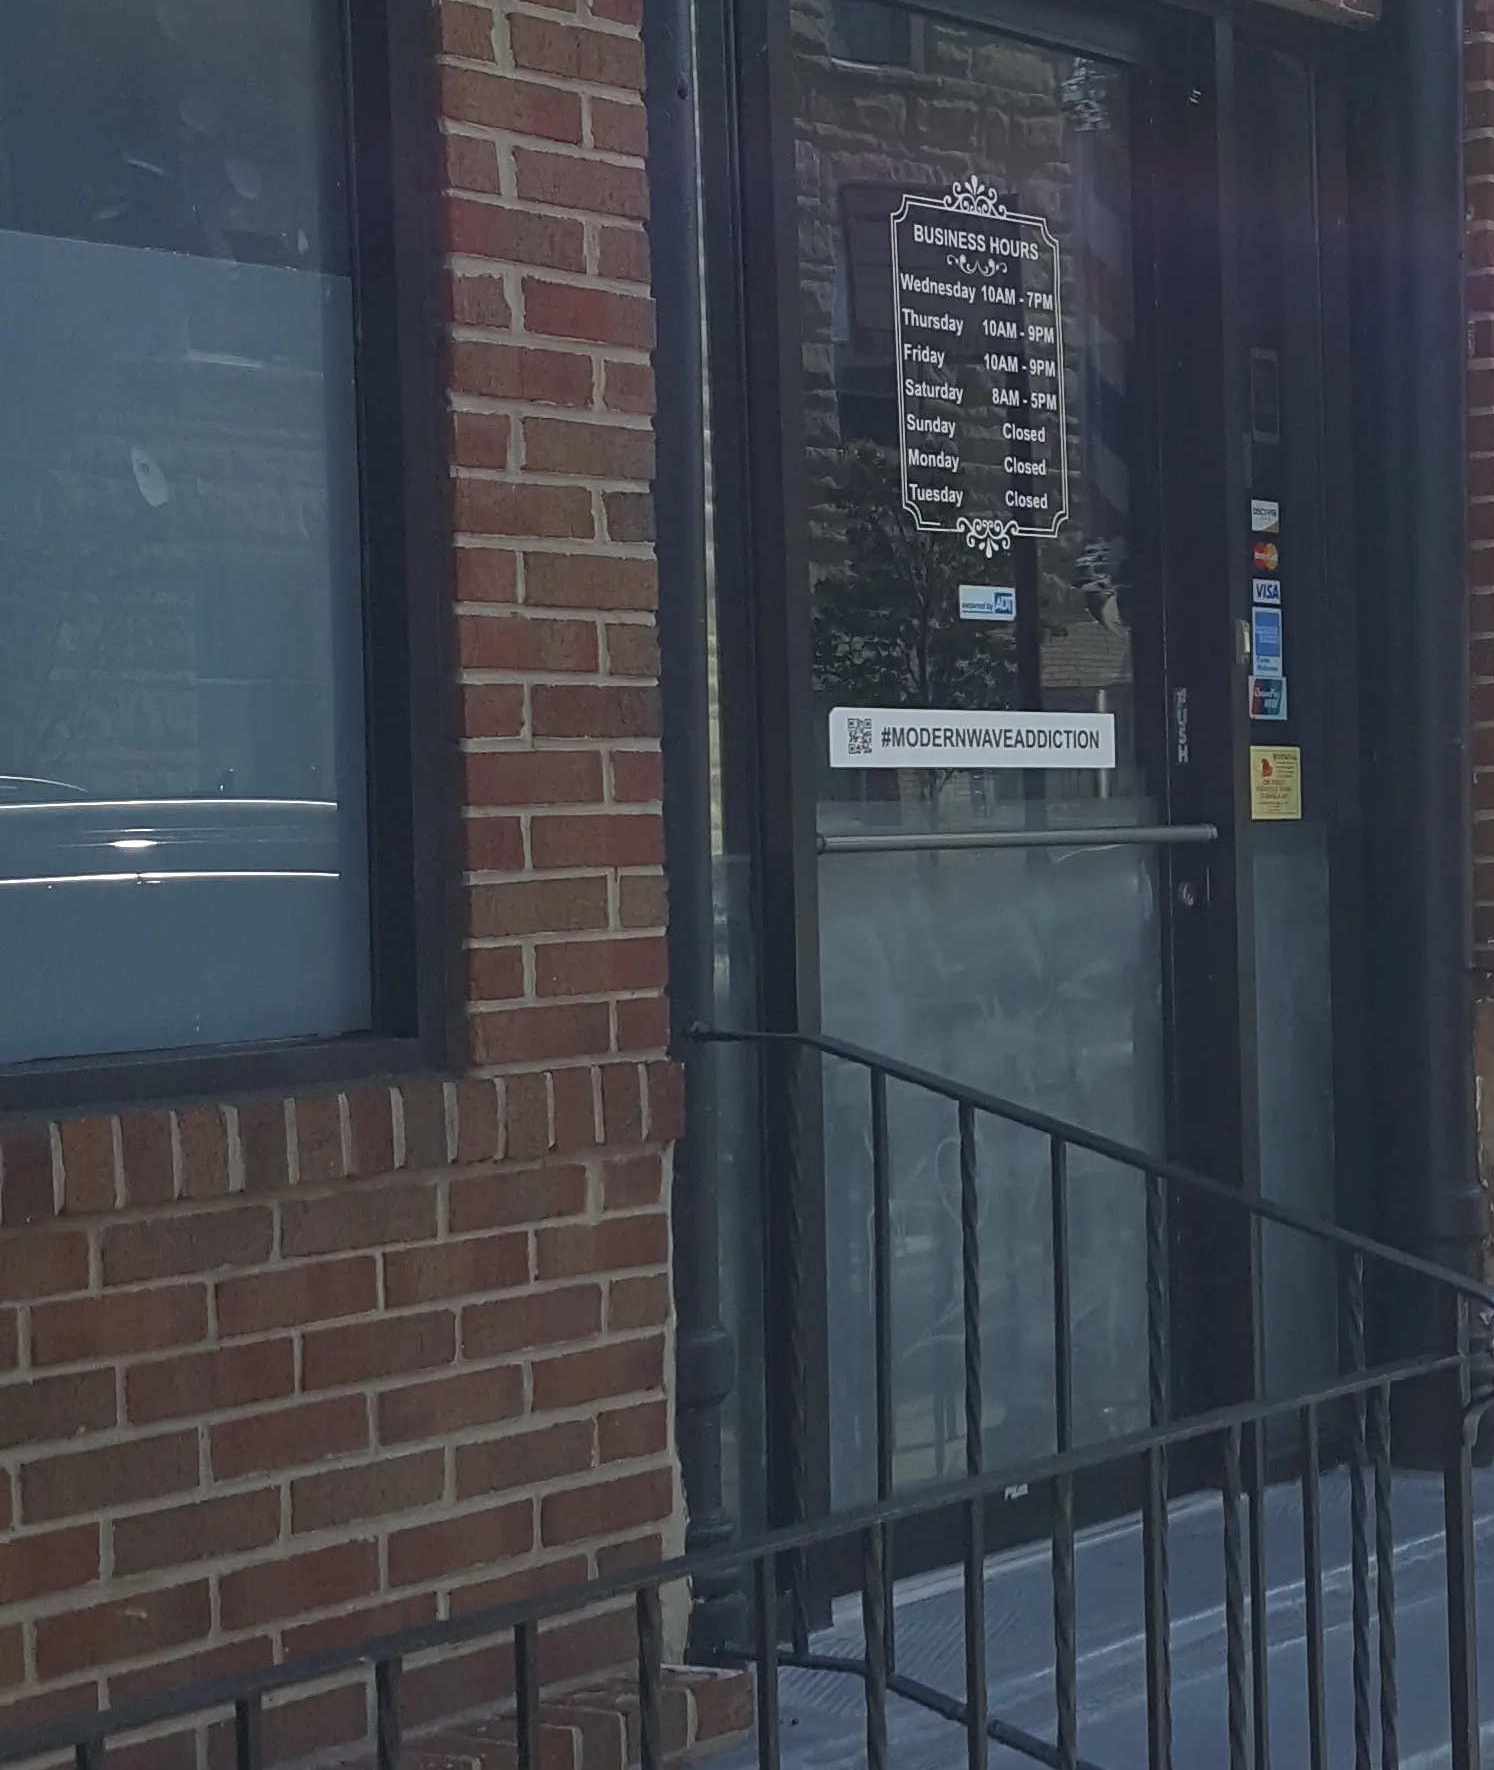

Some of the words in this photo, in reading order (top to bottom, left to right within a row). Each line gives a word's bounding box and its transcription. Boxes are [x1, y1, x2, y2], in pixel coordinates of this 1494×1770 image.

[914, 224, 986, 252] BUSINESS
[990, 236, 1039, 260] HOURS
[900, 272, 976, 303] Wednesday
[981, 285, 1016, 305] 10AM
[1027, 291, 1053, 310] 7PM
[902, 308, 964, 336] Thursday
[982, 319, 1017, 338] 10AM
[1028, 325, 1055, 344] 9PM
[904, 344, 945, 368] Friday
[984, 353, 1019, 372] 10AM
[1029, 359, 1056, 377] 9PM
[905, 379, 964, 404] Saturday
[992, 388, 1019, 406] 8AM
[1031, 393, 1057, 410] 5PM
[906, 413, 956, 438] Sunday
[1003, 422, 1046, 442] Closed
[908, 448, 960, 472] Monday
[1004, 456, 1047, 475] Closed
[909, 483, 964, 507] Tuesday
[1005, 490, 1048, 509] Closed
[1256, 584, 1279, 599] VISA
[881, 726, 1100, 749] #MODERNWAVEADDICTION
[1176, 687, 1189, 763] PUSH
